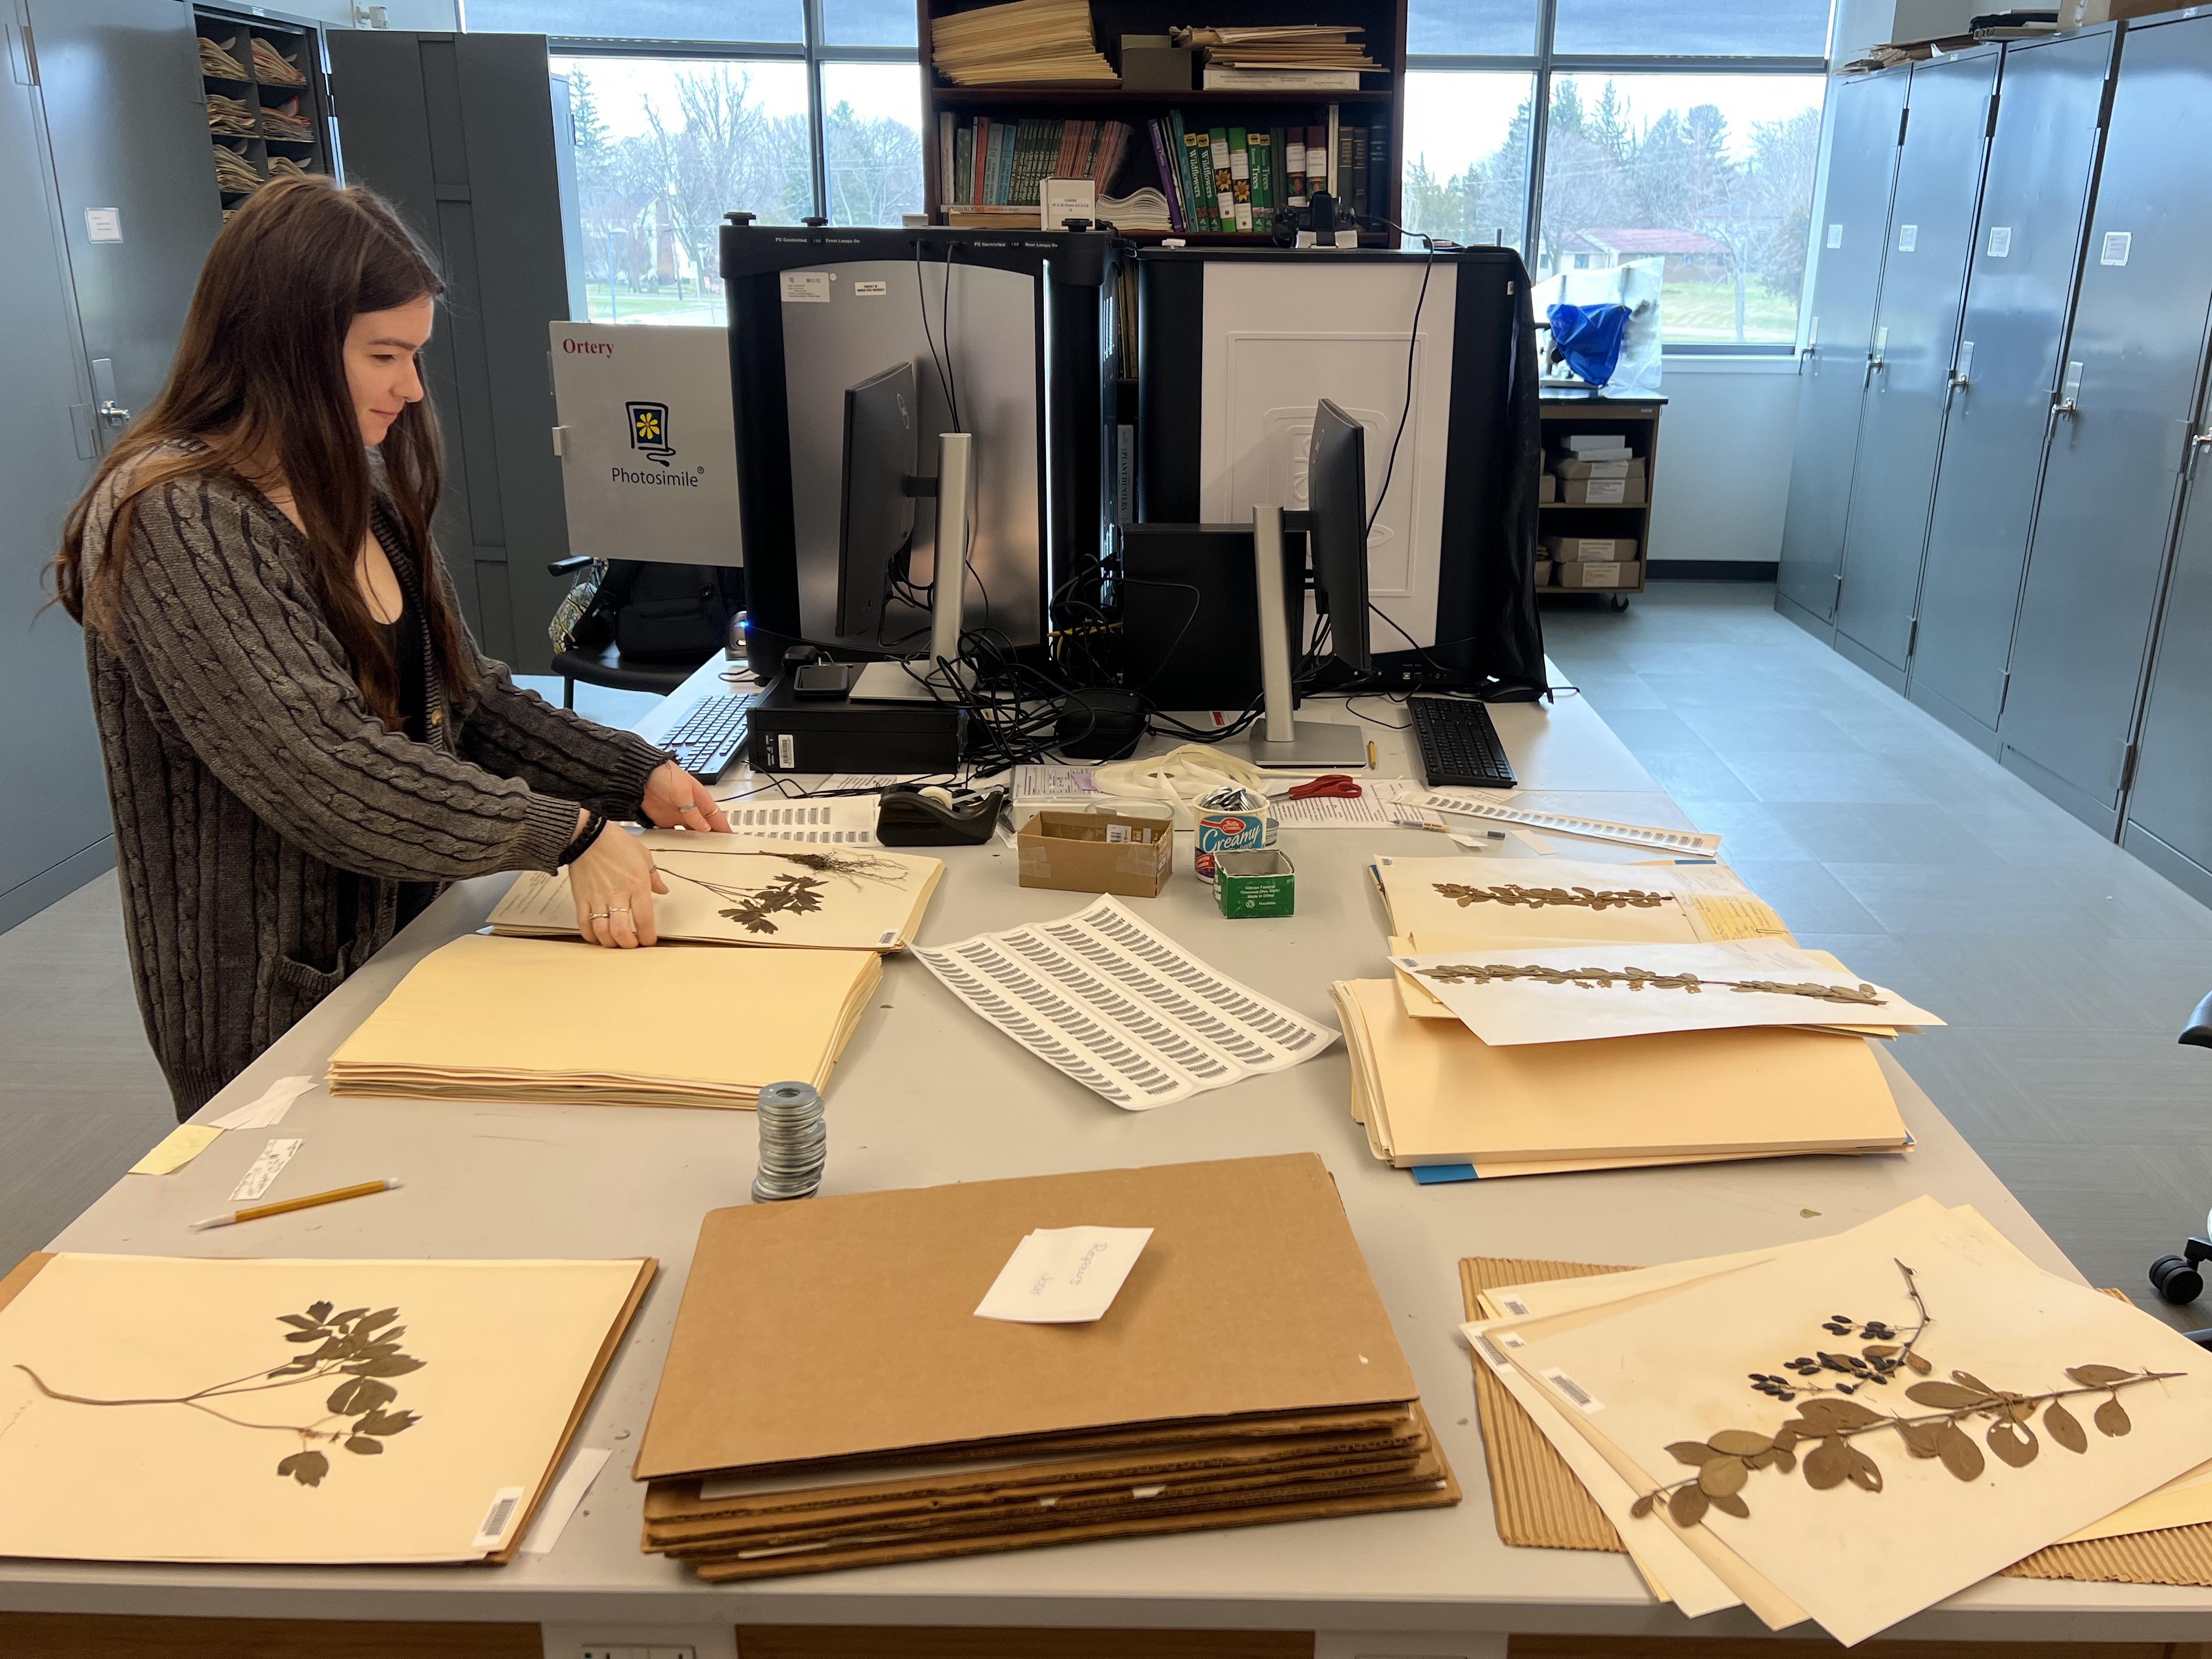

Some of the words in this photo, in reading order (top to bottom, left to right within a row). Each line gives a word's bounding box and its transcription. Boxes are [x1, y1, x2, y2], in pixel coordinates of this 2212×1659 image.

[1189, 149, 1200, 198] Wildflowers
[1201, 150, 1213, 199] Wildflowers
[1262, 166, 1270, 191] Trees
[563, 338, 615, 358] Ortery
[1203, 825, 1261, 854] Creamy
